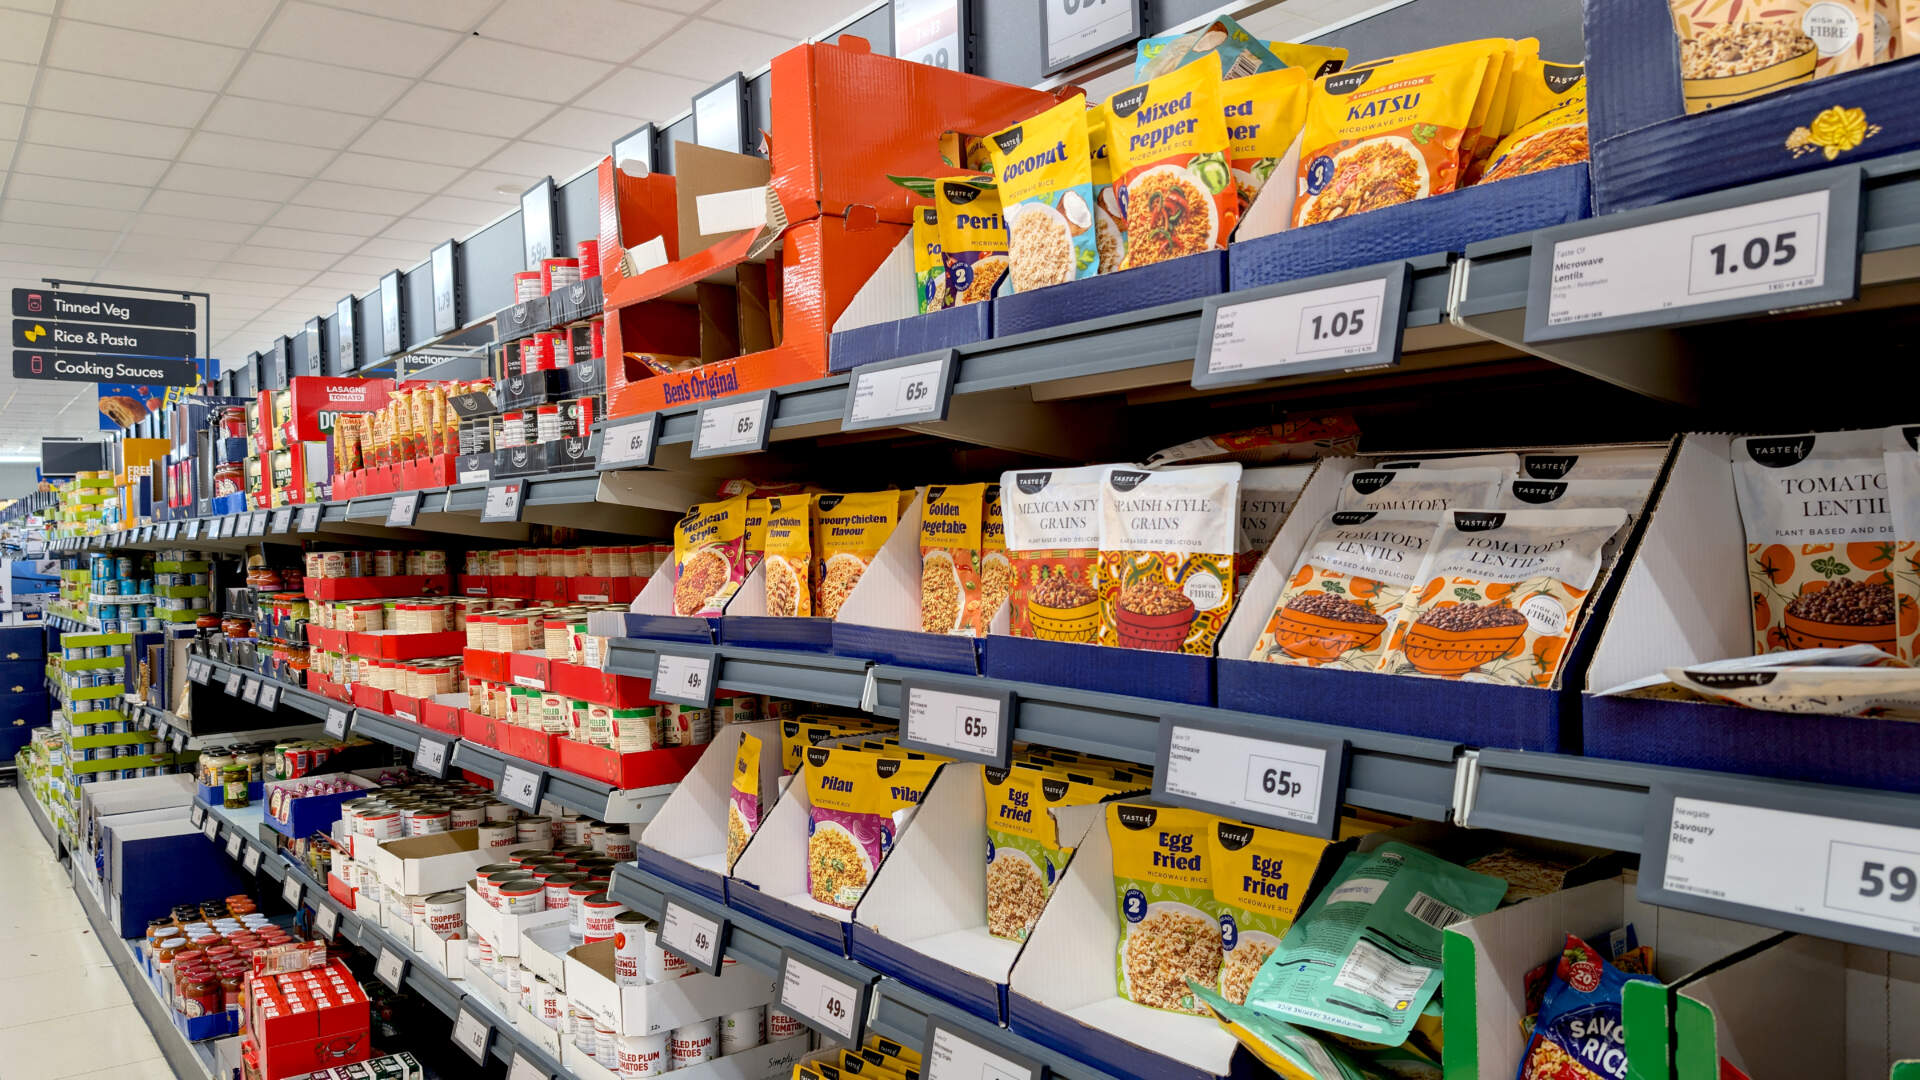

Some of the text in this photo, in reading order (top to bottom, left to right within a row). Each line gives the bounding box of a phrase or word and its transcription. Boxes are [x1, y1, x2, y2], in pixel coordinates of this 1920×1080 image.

[1810, 26, 1848, 39] FIBRE
[1388, 78, 1424, 90] EDITION
[1136, 92, 1192, 128] Mixed
[1346, 92, 1420, 121] KATSU
[1338, 114, 1418, 134] MICROWAVE RICE
[1130, 118, 1198, 152] Pepper
[1175, 140, 1192, 150] RICE
[1002, 140, 1068, 182] Coconut
[947, 190, 966, 198] TASTE
[956, 214, 998, 230] Peri
[1710, 230, 1797, 276] 1.05
[1554, 257, 1604, 272] Microwave
[955, 269, 966, 284] 2
[1554, 272, 1584, 283] Lentils
[54, 299, 130, 320] Tinned Veg
[1312, 308, 1365, 340] 1.05
[54, 330, 138, 347] Rice & Pasta
[55, 360, 164, 378] Cooking Sauces
[326, 386, 367, 394] LASAGNE
[662, 371, 740, 405] Ben's Original
[906, 382, 928, 401] 65p
[737, 417, 754, 434] 65p
[630, 436, 642, 450] 65p
[1755, 447, 1792, 455] TASTE
[1019, 478, 1041, 486] TASTE
[1113, 474, 1134, 483] TASTE
[1518, 487, 1549, 495] TASTE
[929, 502, 960, 516] Golden
[1018, 498, 1071, 514] MEXICAN
[1114, 500, 1212, 513] SPANISH STYLE
[683, 510, 729, 535] Mexican
[851, 514, 888, 525] Chicken
[1040, 517, 1086, 530] GRAINS
[1132, 516, 1180, 530] GRAINS
[688, 526, 719, 544] Style
[832, 526, 864, 536] Flavour
[1775, 529, 1804, 537] PLANT
[1809, 528, 1846, 536] BASED
[1850, 527, 1874, 535] AND
[1336, 530, 1430, 550] TOMATOEY
[1467, 538, 1571, 556] TOMATOEY
[1336, 542, 1406, 563] LENTILS
[1471, 552, 1546, 568] LENTILS
[1333, 560, 1358, 570] BASED
[1360, 564, 1376, 574] AND
[1468, 568, 1495, 578] BASED
[1189, 590, 1217, 599] FIBRE
[1526, 610, 1558, 628] FIBRE
[1530, 602, 1561, 620] HIGH IN
[688, 673, 702, 688] 49p
[964, 716, 988, 738] 65p
[1172, 743, 1200, 754] Microwave
[1170, 752, 1192, 762] Jasmine
[822, 776, 853, 792] Pilau
[1262, 768, 1302, 798] 65p
[1008, 787, 1029, 807] Egg
[1000, 804, 1032, 823] Fried
[1122, 814, 1144, 822] TASTE
[1675, 806, 1710, 820] Newgate
[994, 821, 1020, 832] MICROWAVE
[1673, 820, 1715, 836] Savoury
[1159, 832, 1194, 853] Egg
[1221, 831, 1240, 841] TASTE
[1672, 832, 1694, 846] Rice
[1152, 851, 1201, 872] Fried
[1251, 854, 1283, 880] Egg
[1146, 870, 1188, 882] MICROWAVE
[1858, 860, 1918, 903] 59
[1243, 876, 1289, 900] Fried
[1128, 897, 1140, 913] 2
[1237, 896, 1293, 915] MICROWAVE RICE
[430, 913, 461, 923] CHOPPED
[431, 920, 464, 932] TOMATOES
[1222, 924, 1233, 941] 2
[695, 932, 710, 951] 49p
[1574, 970, 1592, 985] 20
[826, 997, 846, 1020] 49p
[692, 1036, 712, 1048] PLUM
[638, 1051, 660, 1062] PLUM
